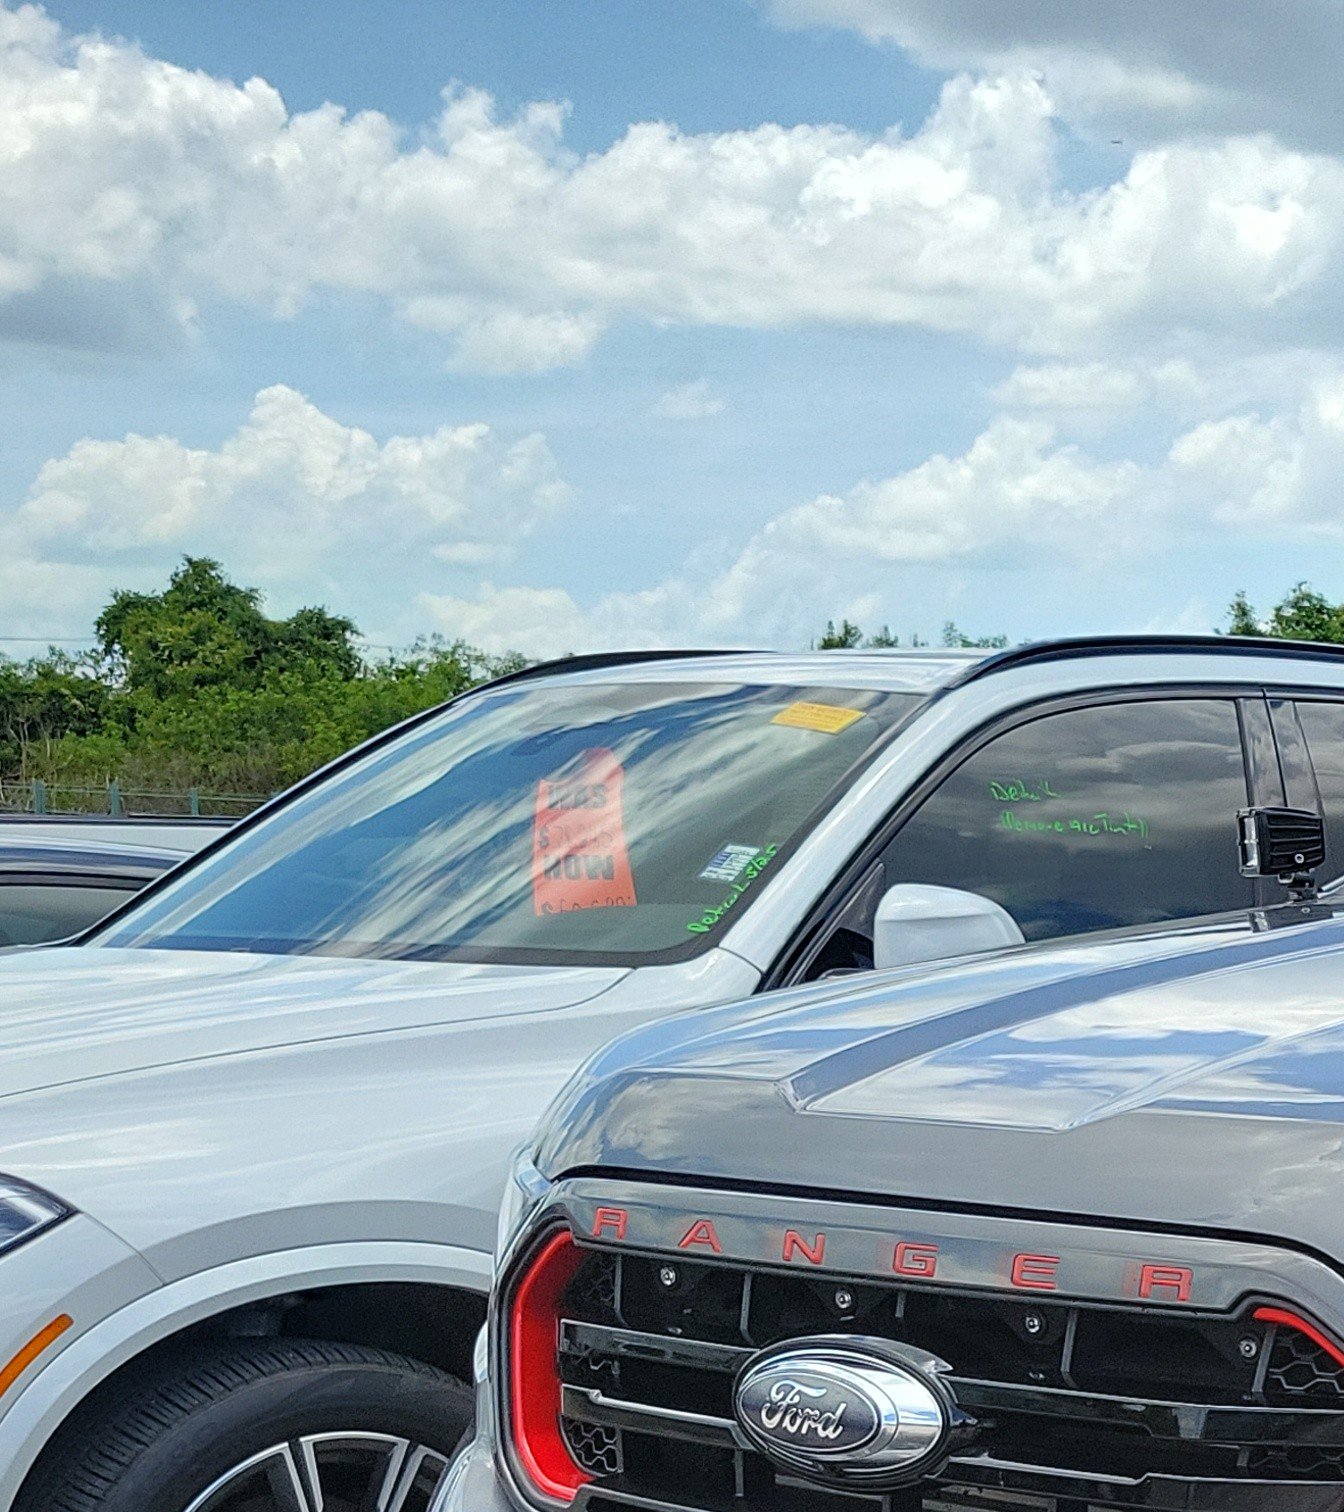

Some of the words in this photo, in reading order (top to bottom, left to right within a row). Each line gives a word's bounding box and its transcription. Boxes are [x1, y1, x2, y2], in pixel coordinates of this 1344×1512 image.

[544, 853, 616, 882] NOW
[592, 1206, 1194, 1302] RANGER
[761, 1379, 847, 1441] Ford
